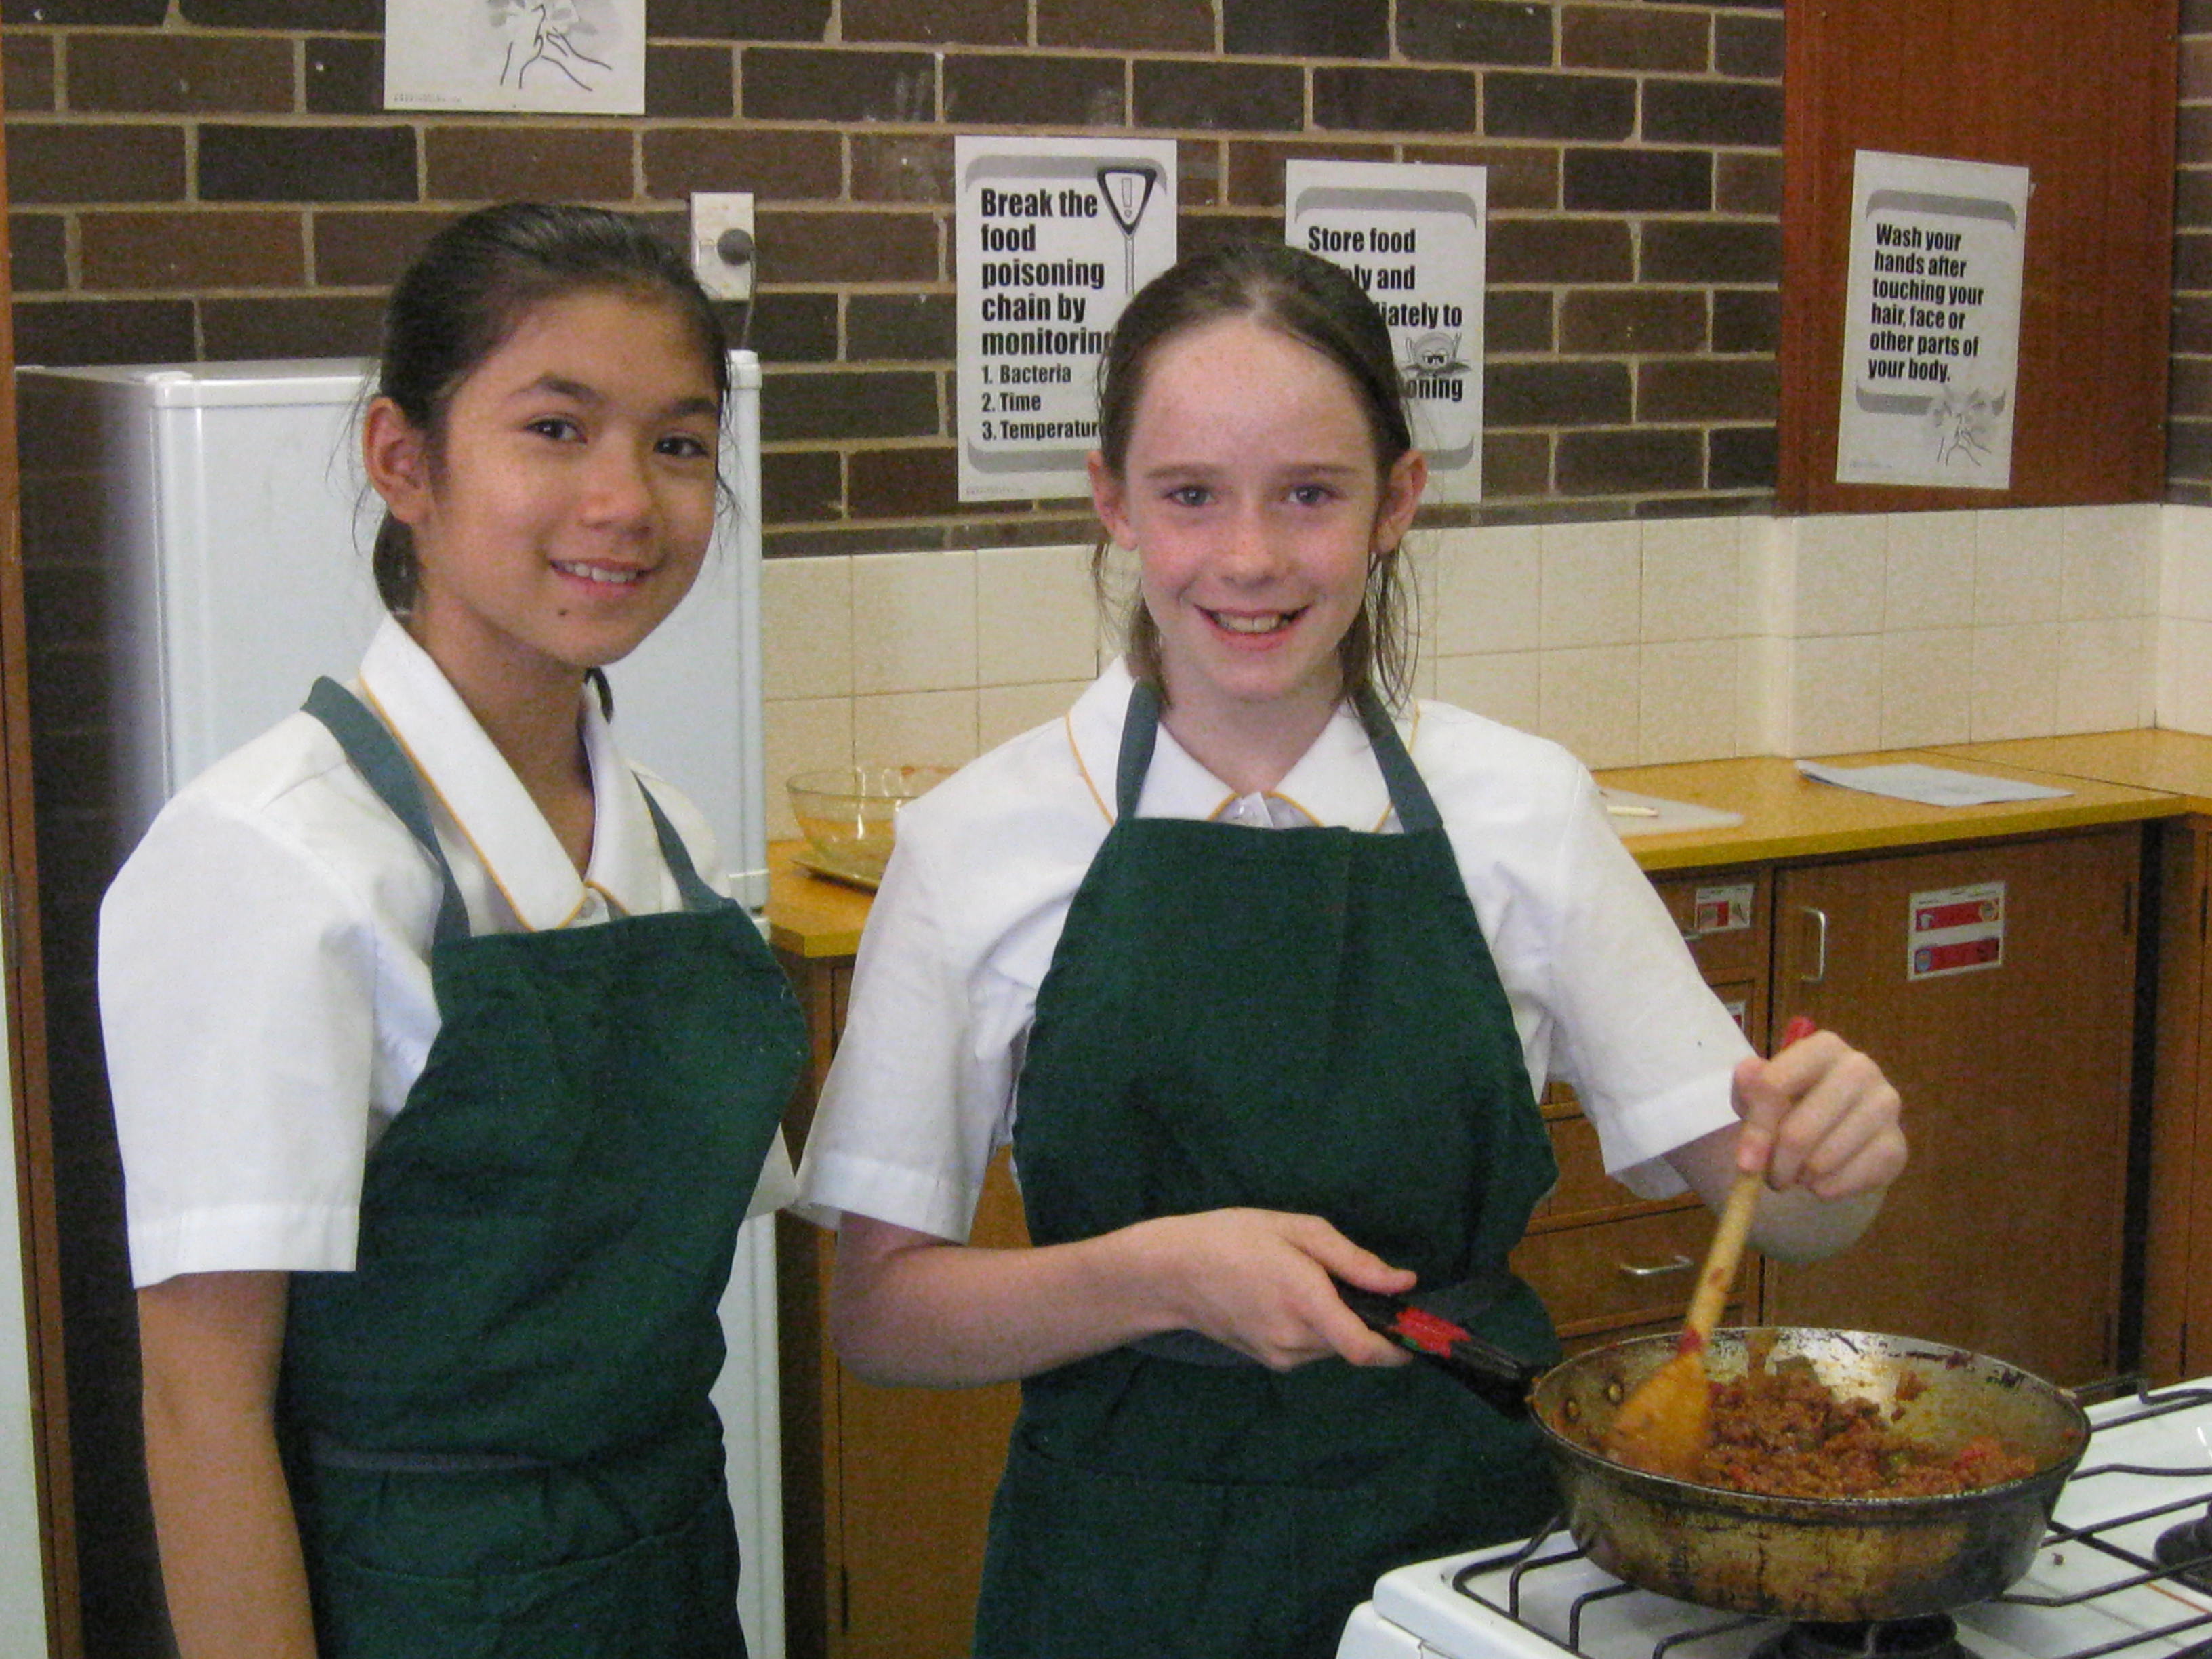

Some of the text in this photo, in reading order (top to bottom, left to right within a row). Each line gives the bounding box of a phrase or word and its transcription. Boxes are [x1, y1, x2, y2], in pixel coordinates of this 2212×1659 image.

[981, 189, 1097, 217] Break the
[981, 224, 1035, 251] food
[1309, 226, 1415, 253] Store food
[1877, 224, 1961, 251] Wash your
[983, 259, 1104, 289] poisoning
[1875, 251, 1966, 277] hands after
[1378, 266, 1415, 289] and
[1873, 277, 1984, 305] touching your
[983, 293, 1085, 323] chain by
[1443, 305, 1462, 327] to
[1872, 303, 1965, 329] hair, face or
[1870, 331, 1978, 356] other parts of
[983, 364, 1071, 384] 1. Bacteria
[1869, 359, 1950, 383] your body.
[982, 393, 1040, 412] 2. Time
[982, 421, 1097, 441] 3. Temperatur
